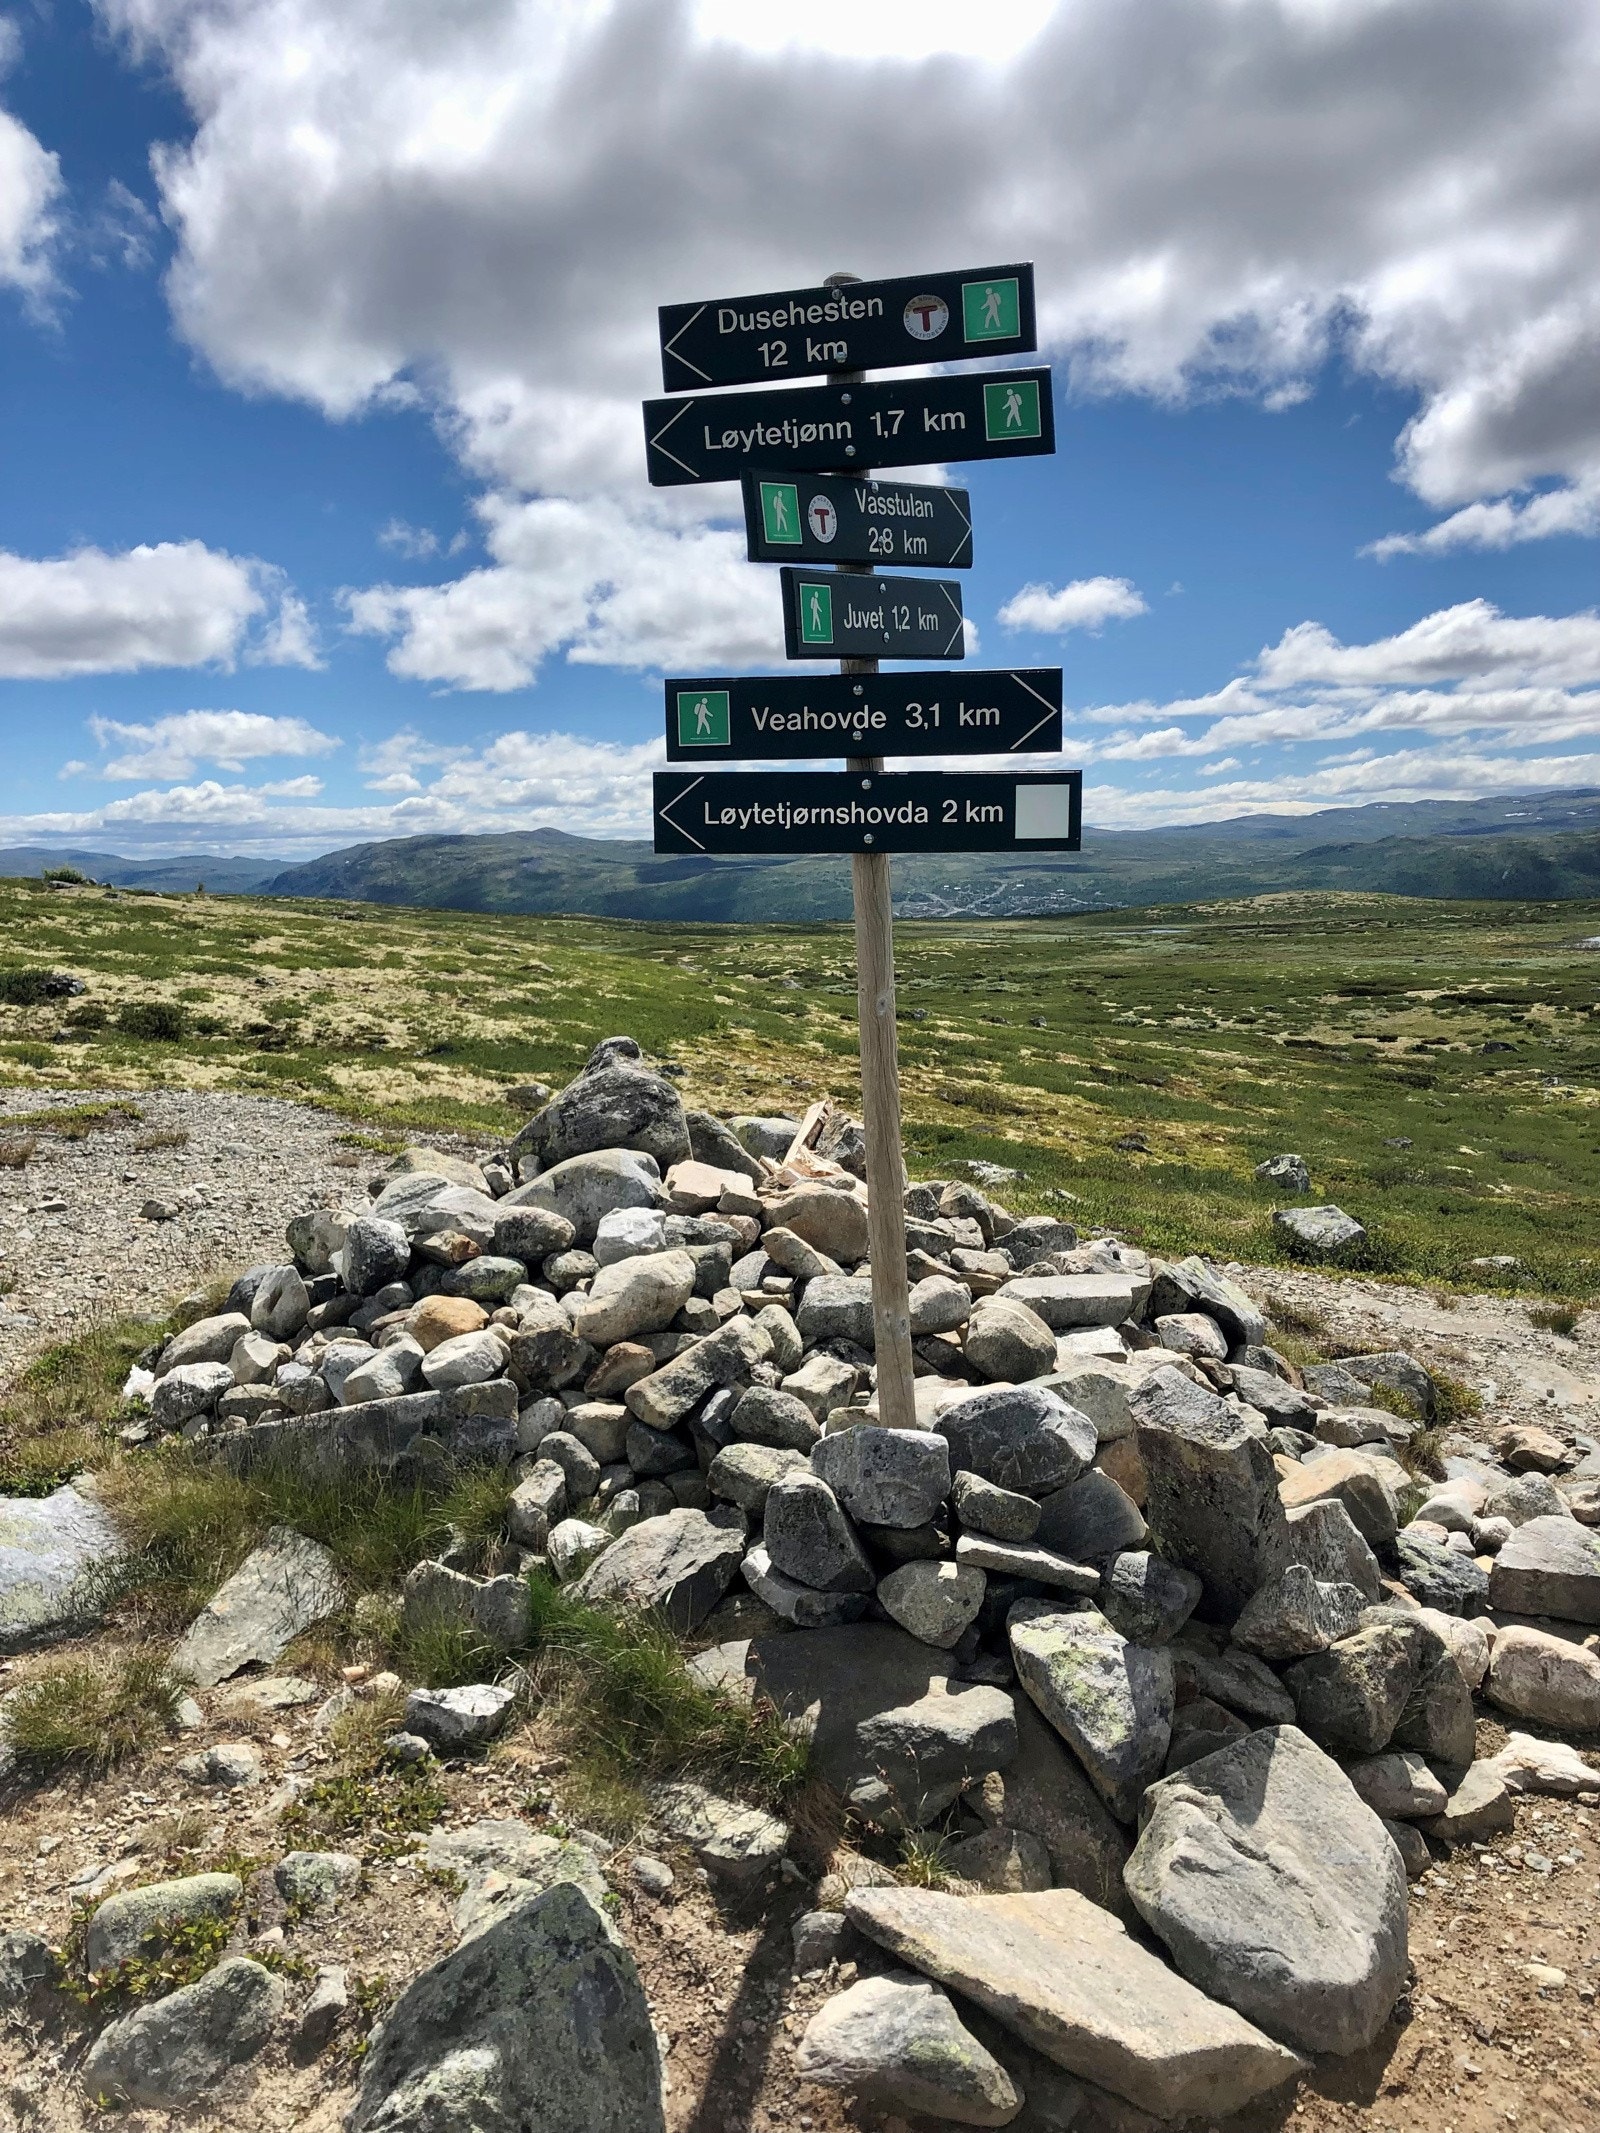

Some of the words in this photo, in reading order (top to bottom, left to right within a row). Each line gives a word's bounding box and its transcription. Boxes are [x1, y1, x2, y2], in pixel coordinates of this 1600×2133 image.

[718, 297, 883, 334] Dusehesten
[757, 341, 787, 367] 12
[807, 338, 848, 363] km
[704, 419, 852, 452] Løytetjønn
[871, 411, 905, 437] 1,7
[925, 408, 966, 432] km
[855, 488, 934, 518] Vasstulan
[868, 527, 893, 555] 2,8
[904, 530, 927, 554] km
[844, 603, 885, 630] Juvet
[891, 606, 910, 632] 1,2
[918, 607, 939, 630] km
[751, 704, 887, 731] Veahovde
[905, 702, 940, 729] 3,1
[960, 702, 1000, 727] km
[704, 800, 929, 829] Løytetjørnshovda
[942, 800, 958, 823] 2
[966, 800, 1003, 823] km
